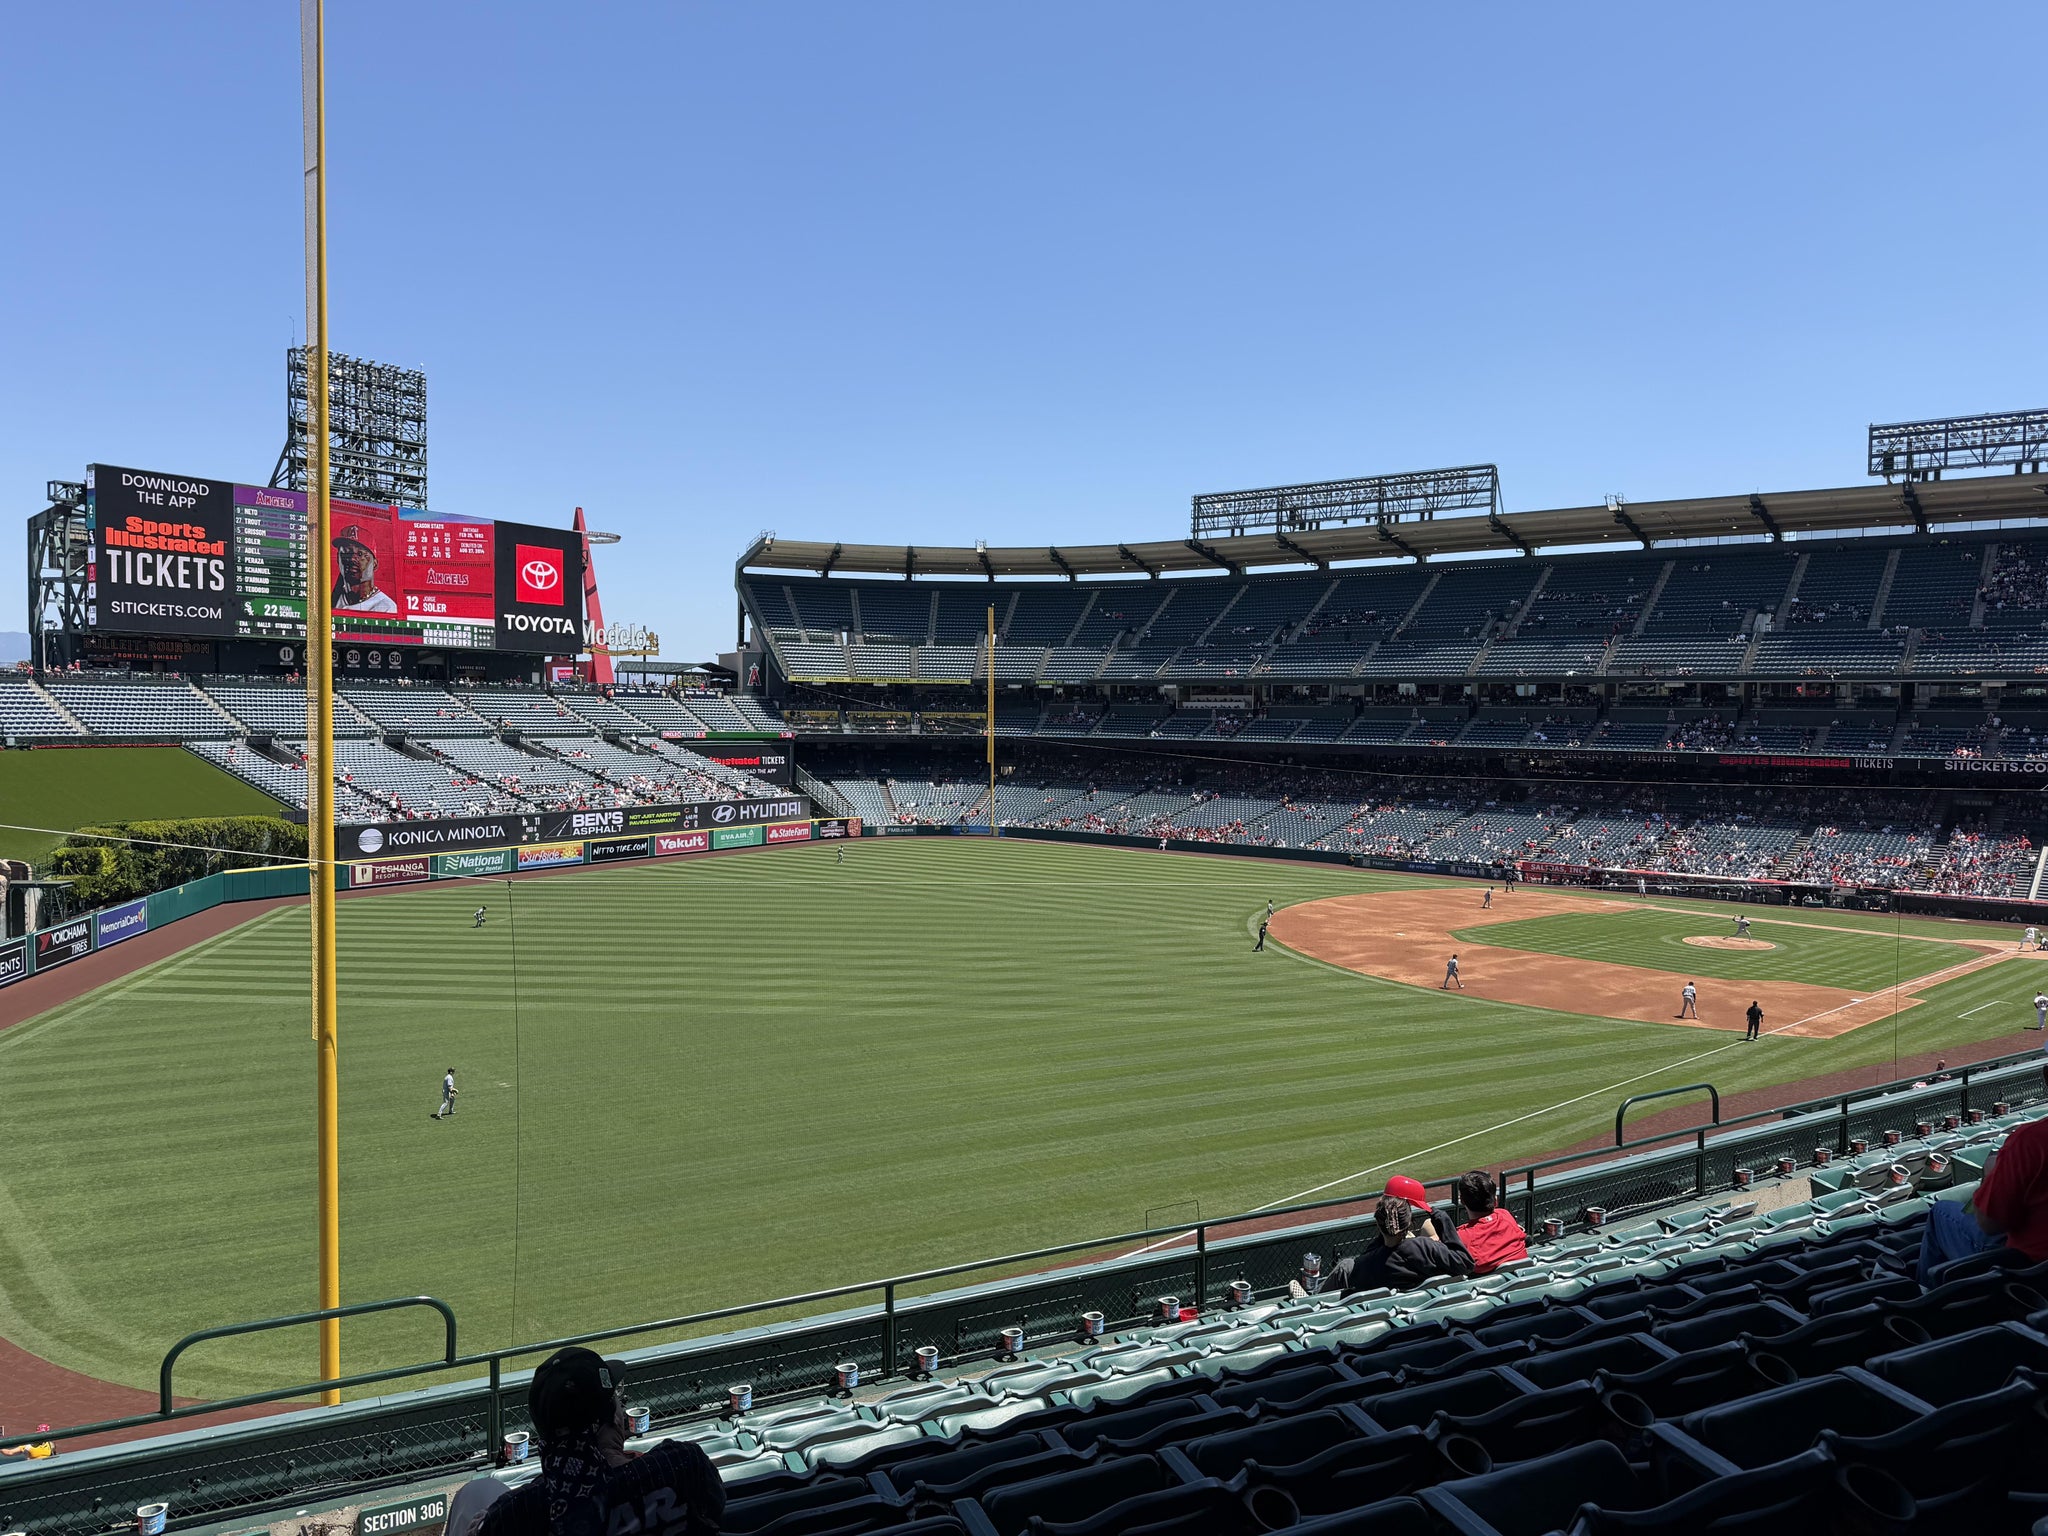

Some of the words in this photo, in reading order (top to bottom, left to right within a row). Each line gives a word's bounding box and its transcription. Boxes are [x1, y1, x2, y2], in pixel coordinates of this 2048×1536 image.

[122, 474, 209, 496] DOWNLOAD
[136, 491, 163, 506] THE
[168, 494, 196, 509] APP
[126, 516, 206, 540] Sports
[106, 527, 225, 556] Illustrated
[106, 550, 224, 591] TICKETS
[426, 568, 469, 585] ANGELS
[111, 601, 222, 619] SITICKETS.COM
[407, 596, 419, 610] 12
[423, 603, 447, 613] SOLER
[264, 604, 278, 617] 22
[504, 614, 576, 634] TOYOTA
[583, 620, 646, 647] Modelo
[148, 641, 210, 654] BOURBON
[283, 649, 291, 659] 11
[348, 652, 359, 661] 30
[369, 653, 380, 661] 42
[391, 654, 400, 662] 50
[762, 756, 785, 765] TICKETS
[1627, 754, 1677, 763] THEATER
[1719, 755, 1769, 766] Sports
[1771, 757, 1850, 768] Illustrated
[1855, 758, 1894, 769] TICKETS
[1944, 760, 2048, 773] SITICKETS.CO
[740, 802, 801, 820] HYUNDAI
[535, 817, 540, 826] 11
[573, 812, 624, 828] BEN'S
[684, 820, 690, 828] C
[389, 830, 444, 846] KONICA
[448, 825, 506, 842] MINOLTA
[535, 833, 540, 841] 2
[573, 825, 623, 836] ASPHALT
[735, 832, 748, 840] AIR
[593, 847, 615, 855] NITTO
[617, 843, 647, 853] TIRE.COM
[659, 834, 705, 850] Yakult
[459, 854, 504, 868] National
[522, 850, 560, 864] Surfside
[375, 862, 424, 874] PECHANGA
[1458, 866, 1477, 876] Modelo
[375, 872, 400, 880] RESORT
[101, 916, 139, 935] MemorialCare
[51, 923, 88, 946] YOKOHAMA
[72, 941, 88, 955] TIRES
[364, 1506, 418, 1533] SECTION
[420, 1501, 444, 1522] 306
